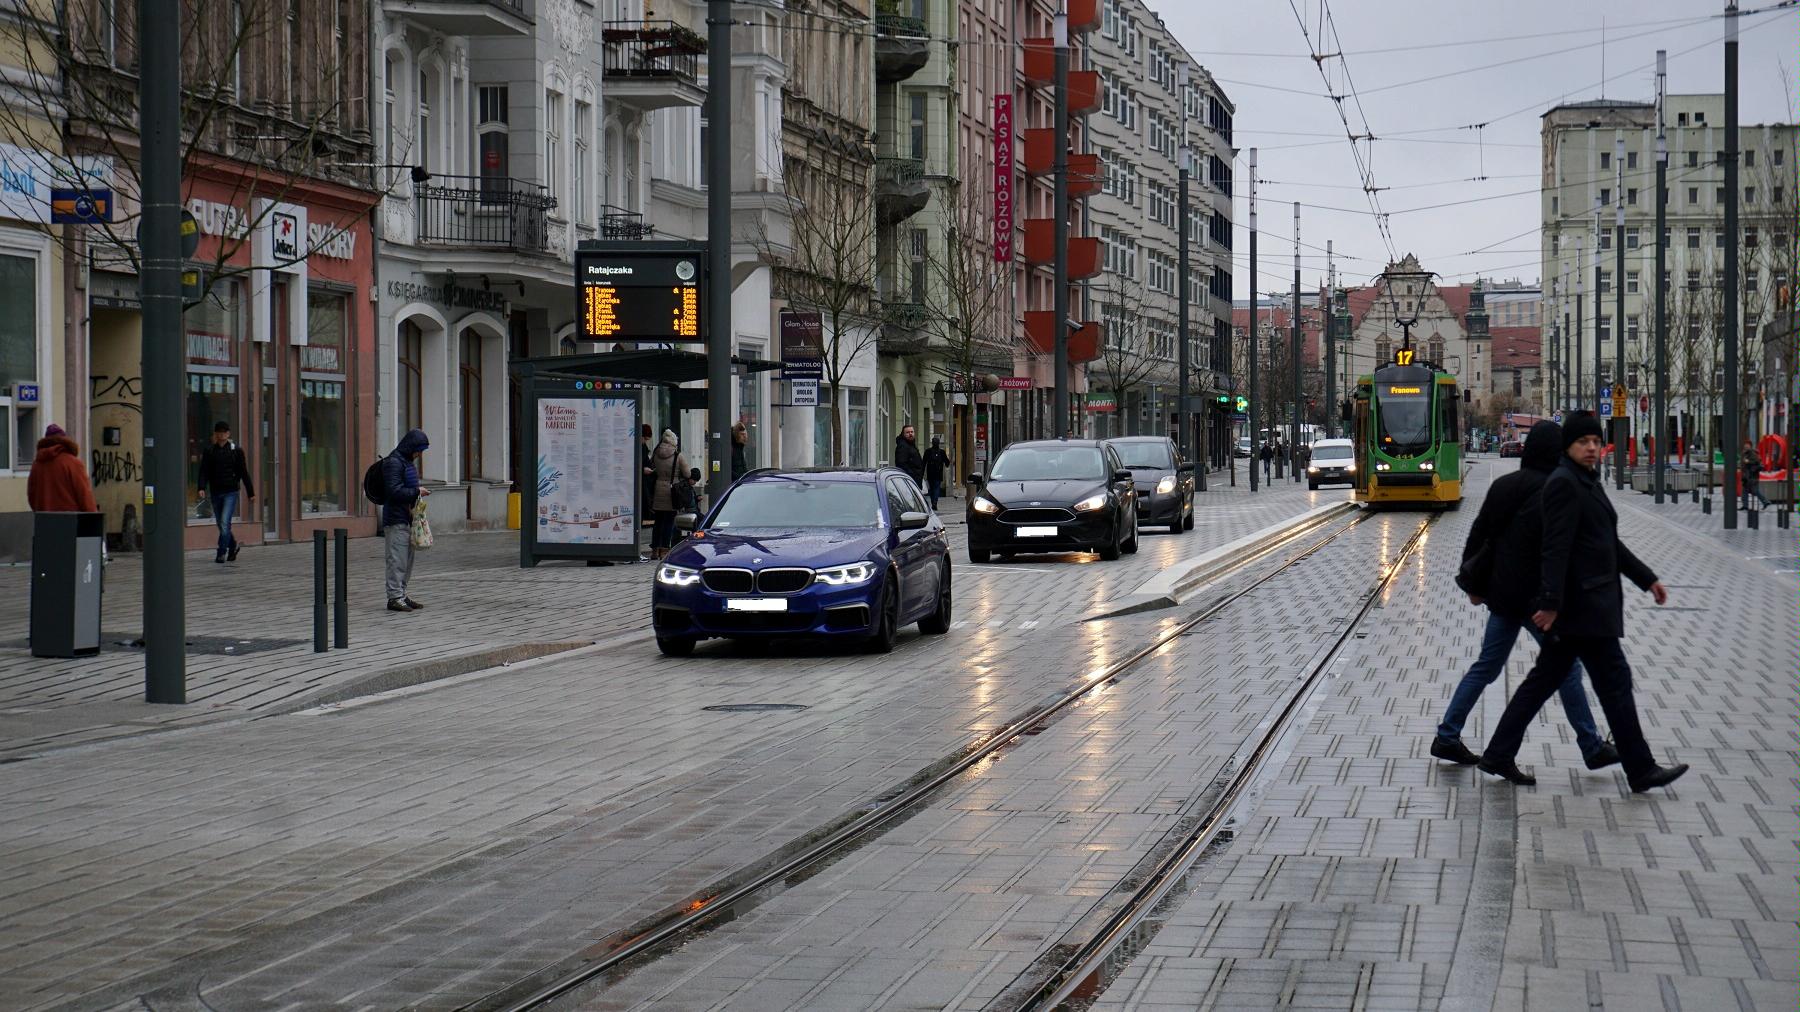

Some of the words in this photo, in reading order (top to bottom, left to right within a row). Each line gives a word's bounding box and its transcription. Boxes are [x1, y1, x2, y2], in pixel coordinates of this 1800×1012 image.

[997, 99, 1009, 167] PASAŻ
[996, 175, 1010, 256] RÓŻOWY
[192, 199, 249, 241] FUTRA
[308, 221, 356, 260] SKÓRY
[588, 266, 633, 275] Ratajczaka
[1397, 350, 1413, 365] 17
[1603, 405, 1609, 413] P
[545, 421, 577, 429] MARCINIE
